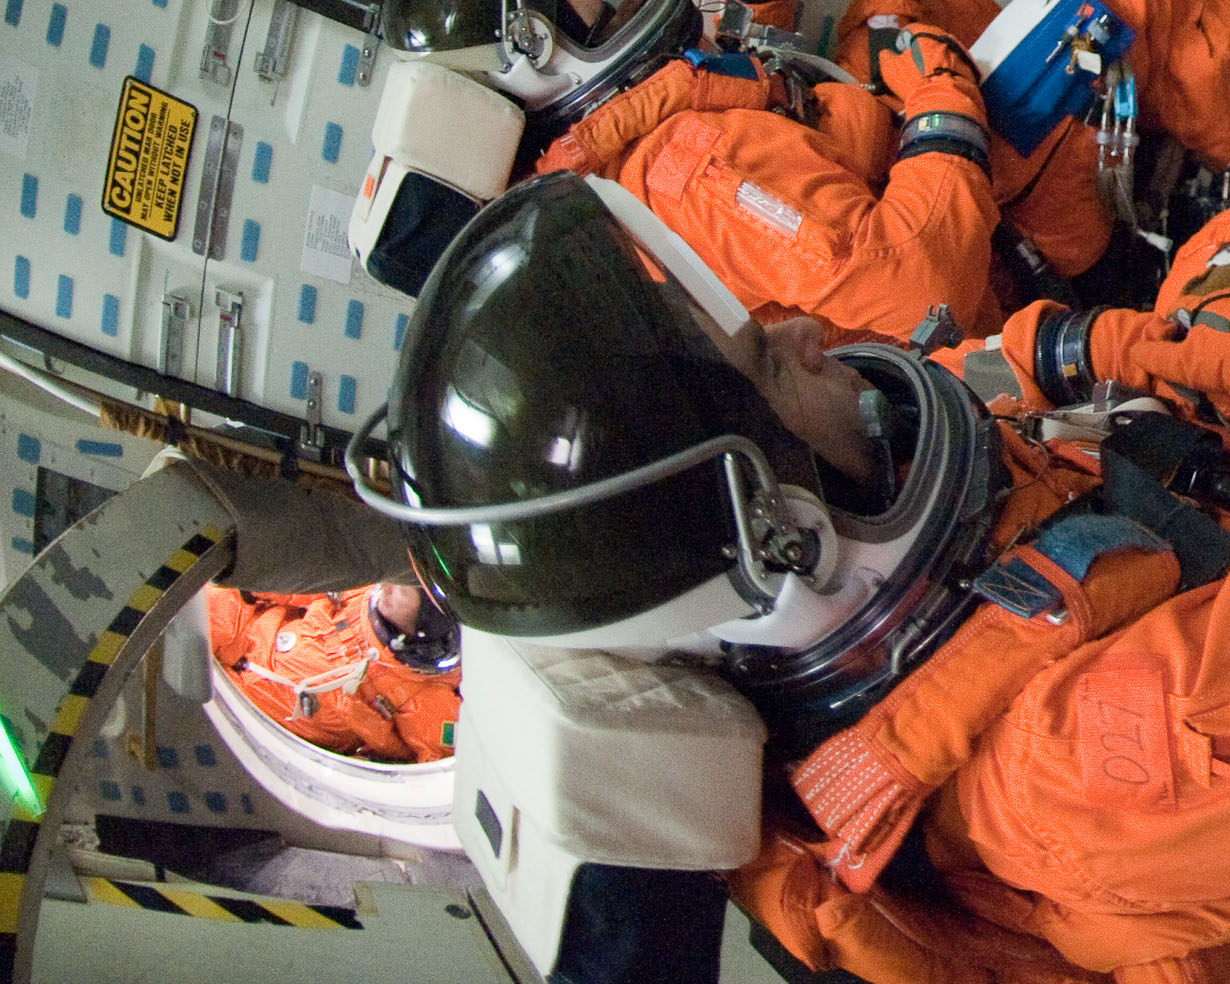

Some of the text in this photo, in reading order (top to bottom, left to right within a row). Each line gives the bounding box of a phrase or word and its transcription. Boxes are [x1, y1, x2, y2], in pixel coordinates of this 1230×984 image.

[110, 89, 151, 209] CAUTION
[140, 102, 168, 220] MAY OPEN WITHOUT WARNING
[154, 125, 177, 208] KEEP LATCHED
[163, 119, 190, 222] WHEN NOT IN USE
